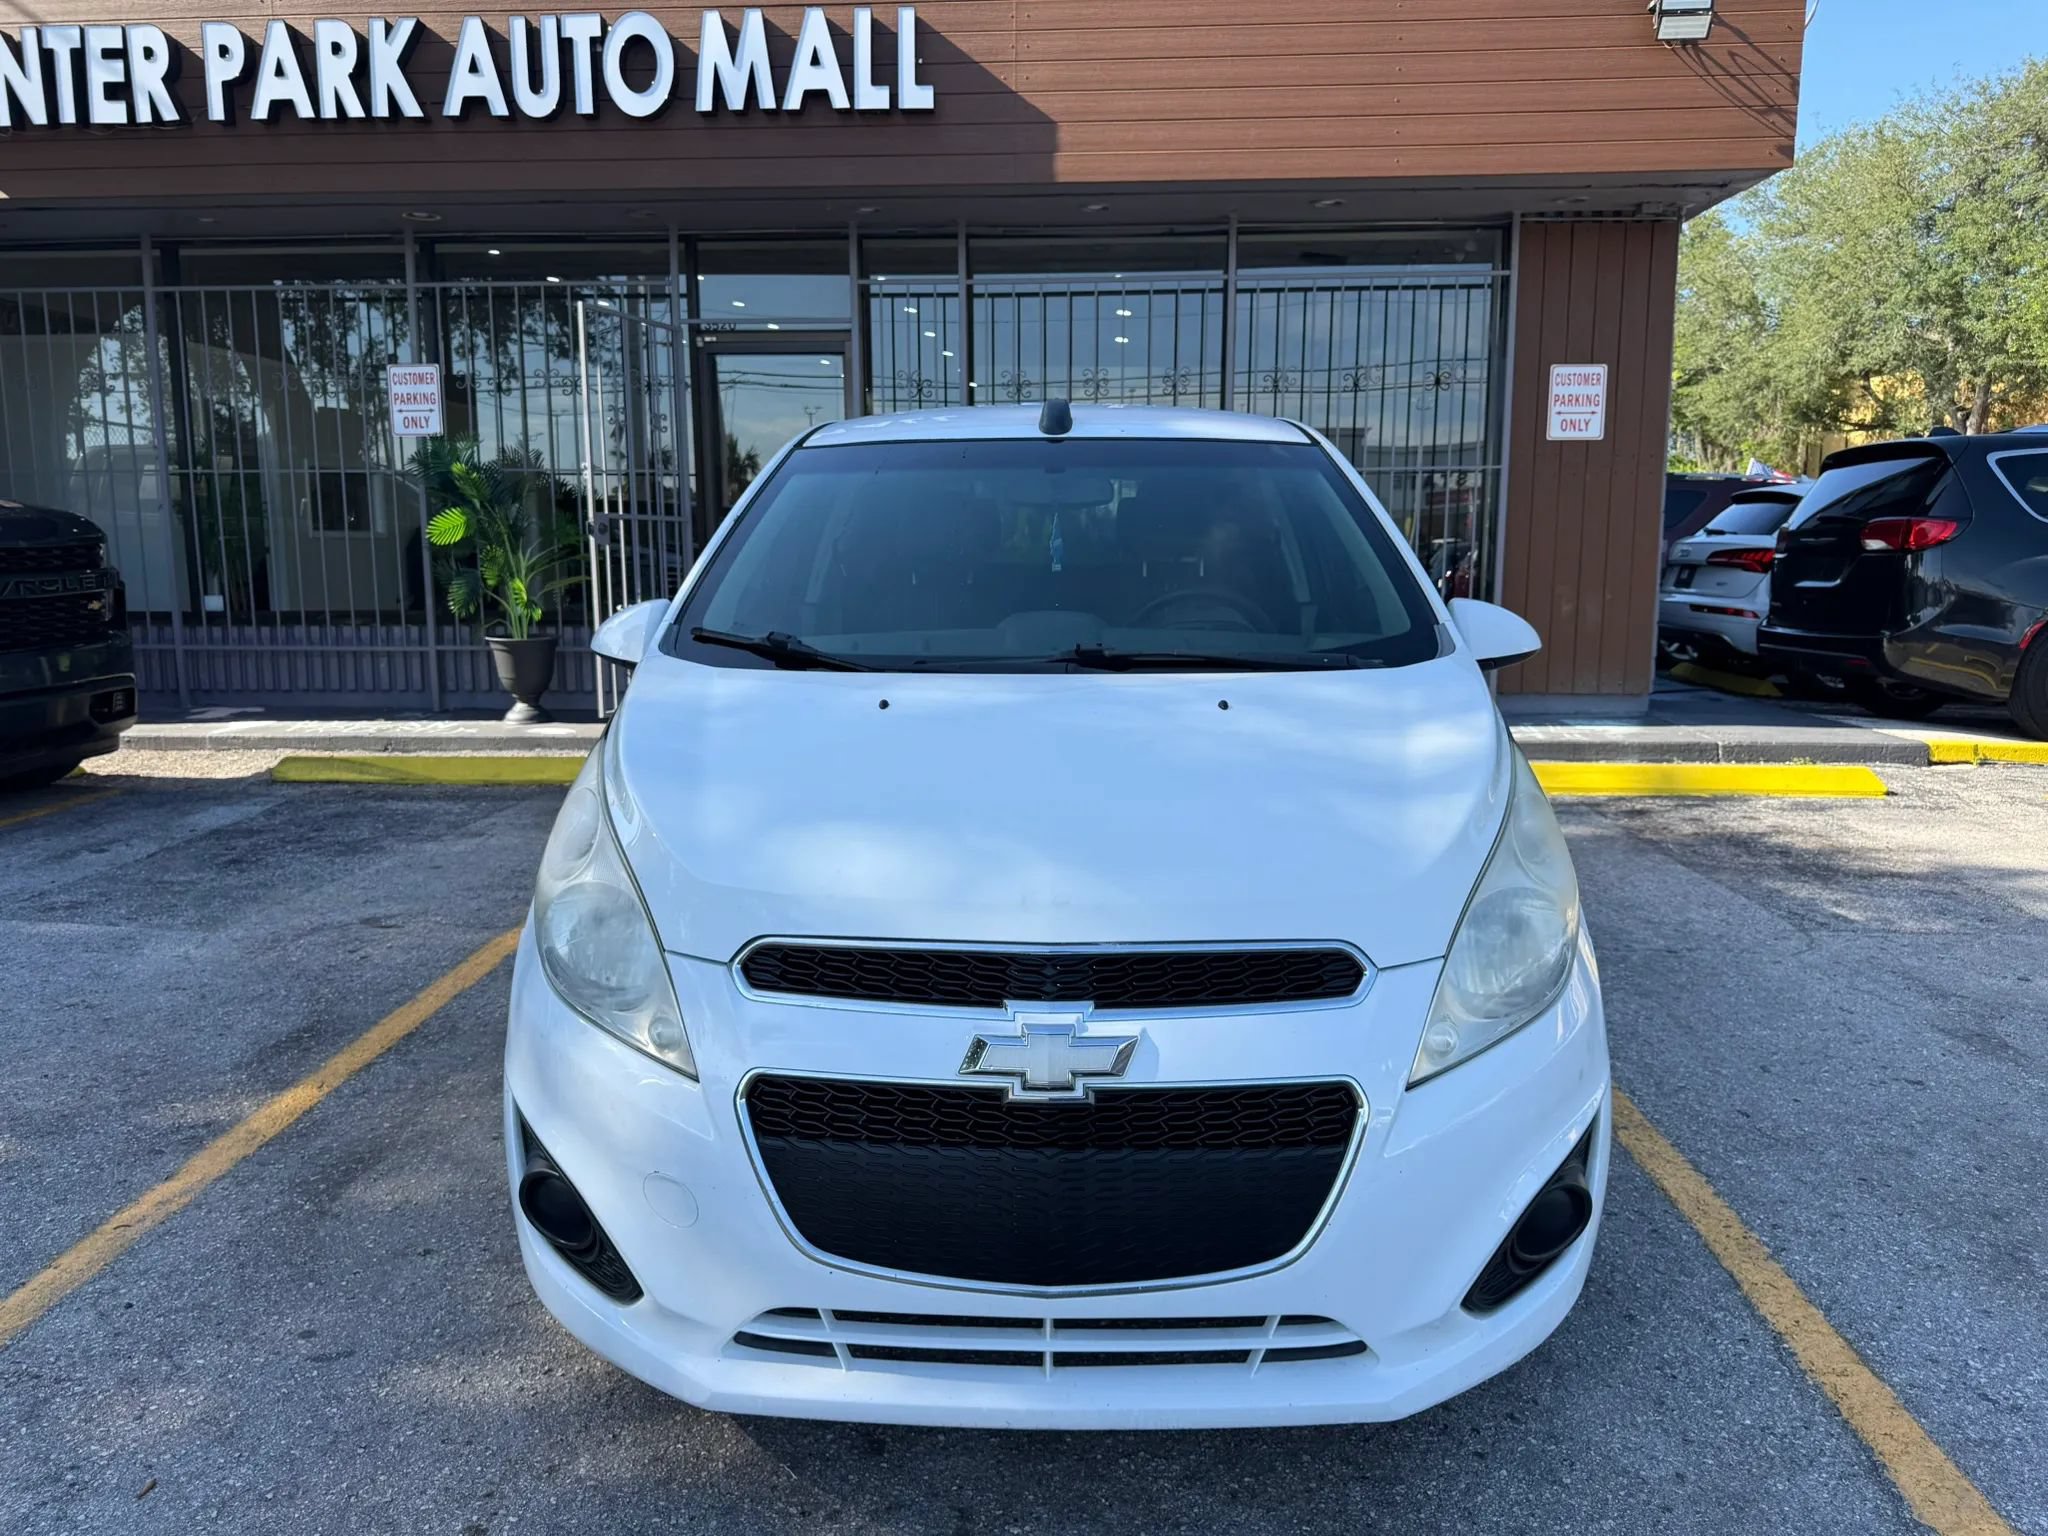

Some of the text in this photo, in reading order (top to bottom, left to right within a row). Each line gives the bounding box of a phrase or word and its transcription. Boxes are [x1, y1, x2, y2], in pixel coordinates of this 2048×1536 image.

[0, 6, 935, 127] NTER PARK AUTO MALL
[392, 372, 436, 385] CUSTOMER
[1554, 372, 1602, 387] CUSTOMER
[393, 392, 437, 406] PARKING
[1553, 393, 1600, 408] PARKING
[403, 415, 430, 429] ONLY
[1560, 418, 1592, 432] ONLY
